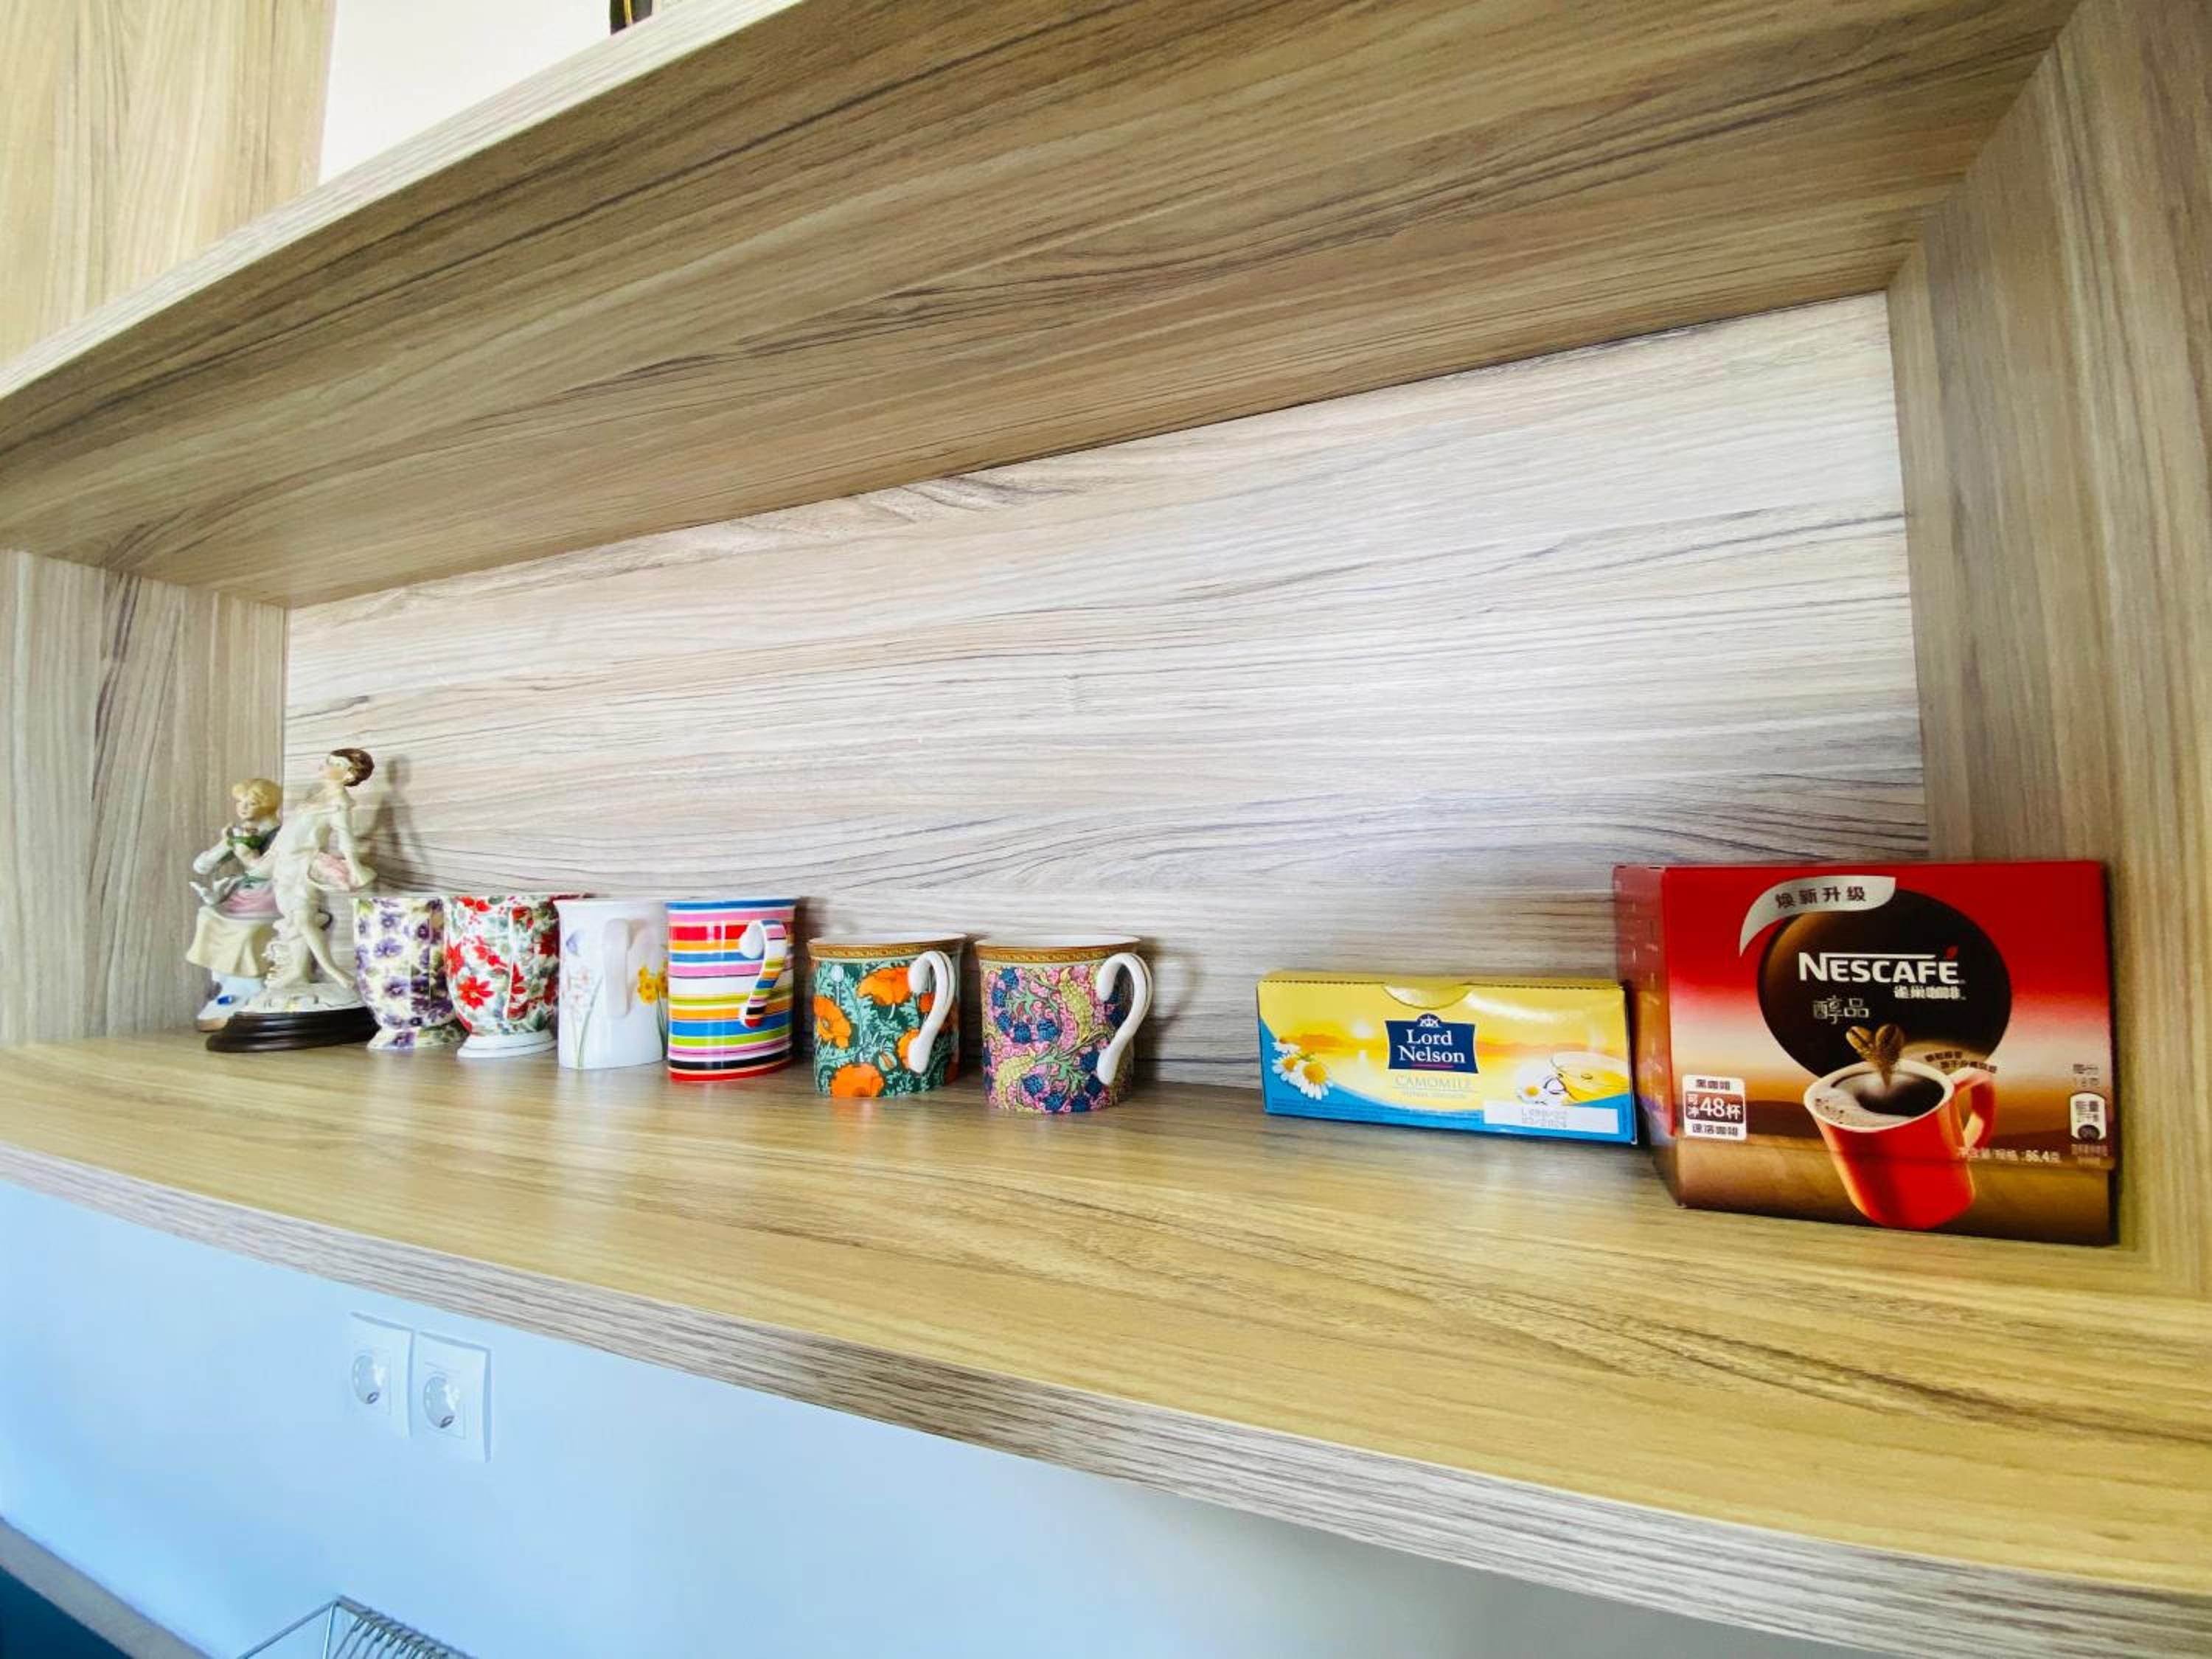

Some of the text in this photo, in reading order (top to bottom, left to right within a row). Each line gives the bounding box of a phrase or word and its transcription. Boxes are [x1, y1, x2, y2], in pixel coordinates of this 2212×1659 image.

[1812, 995, 1870, 1025] 醇品
[1405, 1029, 1453, 1046] Lord
[1397, 1045, 1467, 1064] Nelson
